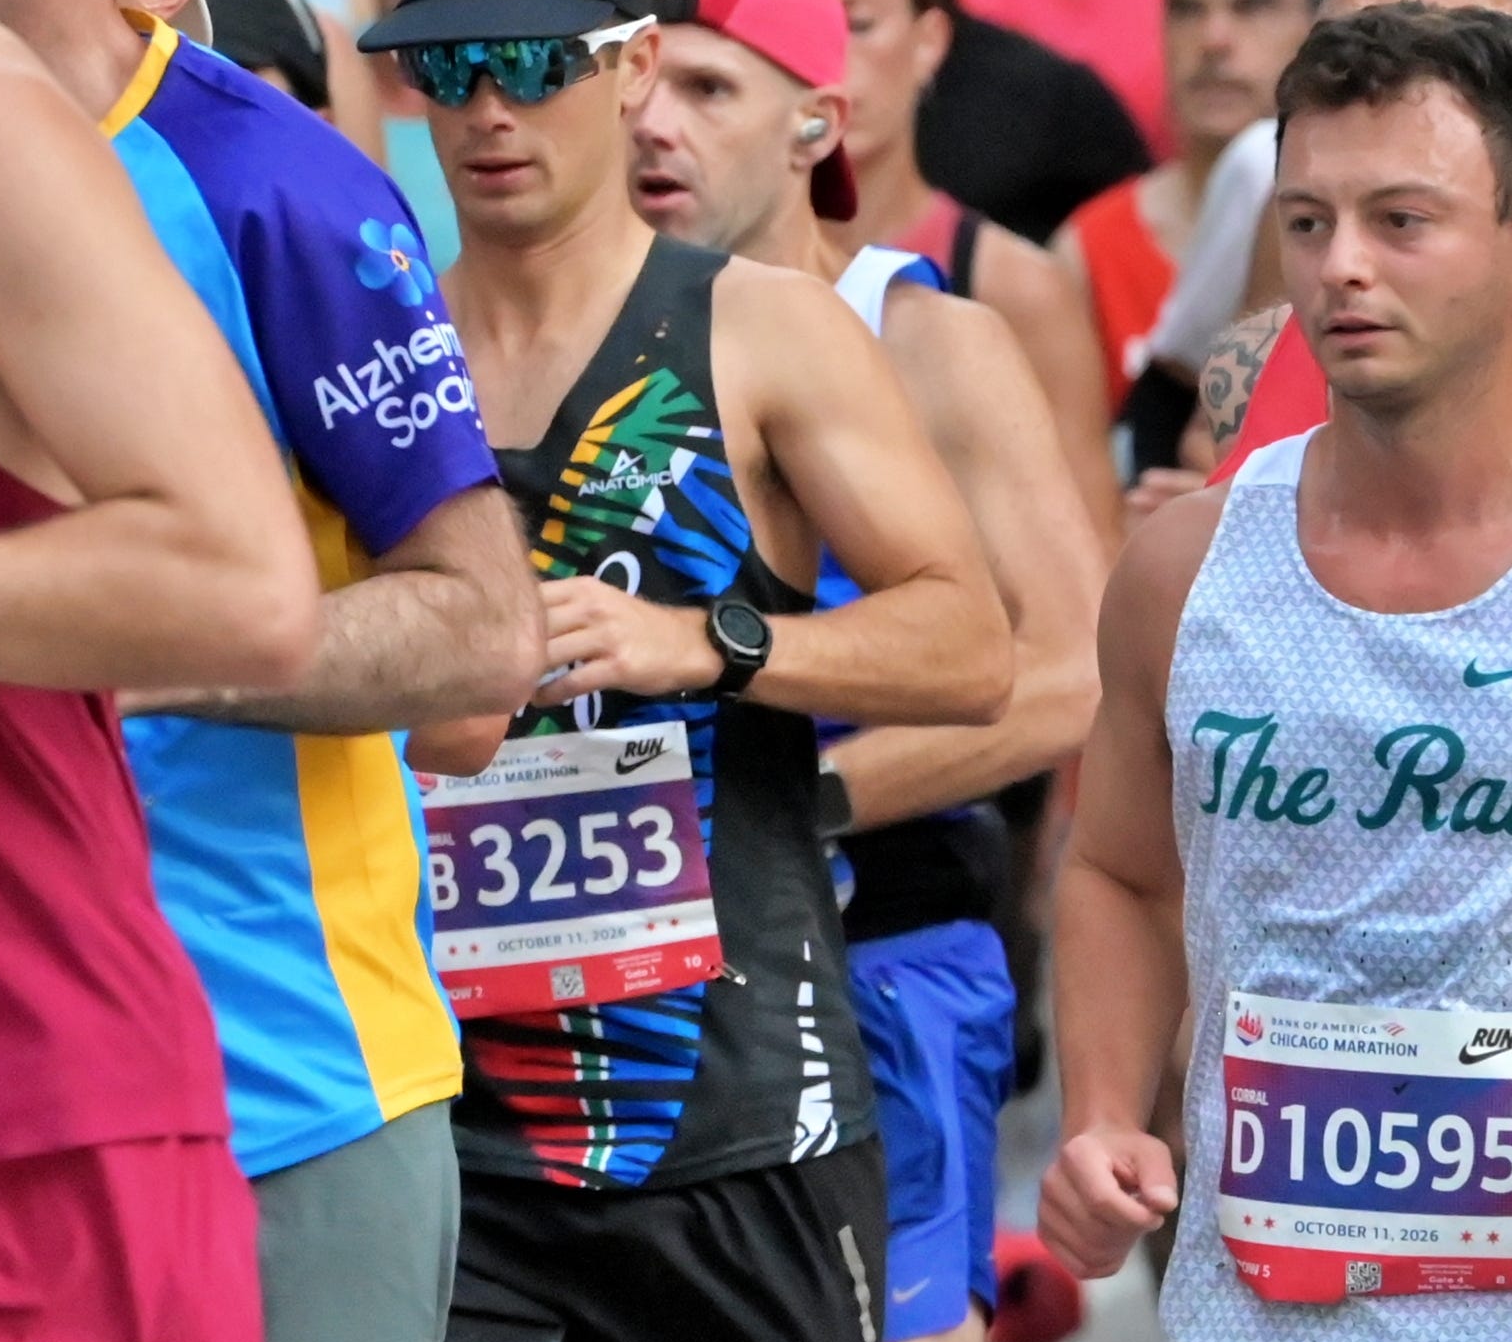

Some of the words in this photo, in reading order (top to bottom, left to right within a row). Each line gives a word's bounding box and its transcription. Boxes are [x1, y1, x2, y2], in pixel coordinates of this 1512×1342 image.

[313, 310, 465, 430] Alzheim
[578, 468, 674, 497] ANATOMIC
[623, 737, 665, 758] RUN
[504, 764, 580, 784] MARATHON
[1193, 711, 1336, 825] The
[469, 805, 683, 908] 3253
[496, 935, 562, 953] OCTOBER
[592, 927, 627, 943] 2026
[1271, 1017, 1300, 1028] BANK
[1303, 1021, 1318, 1031] OF
[1322, 1023, 1377, 1035] AMERICA
[1269, 1031, 1329, 1051] CHICAGO
[1333, 1039, 1419, 1057] MARATHON
[1231, 1086, 1269, 1106] CORRAL
[1231, 1109, 1265, 1174] D
[1294, 1220, 1367, 1239] OCTOBER
[1372, 1226, 1395, 1242] 11,
[1399, 1228, 1440, 1243] 2026
[1262, 1264, 1271, 1277] 5
